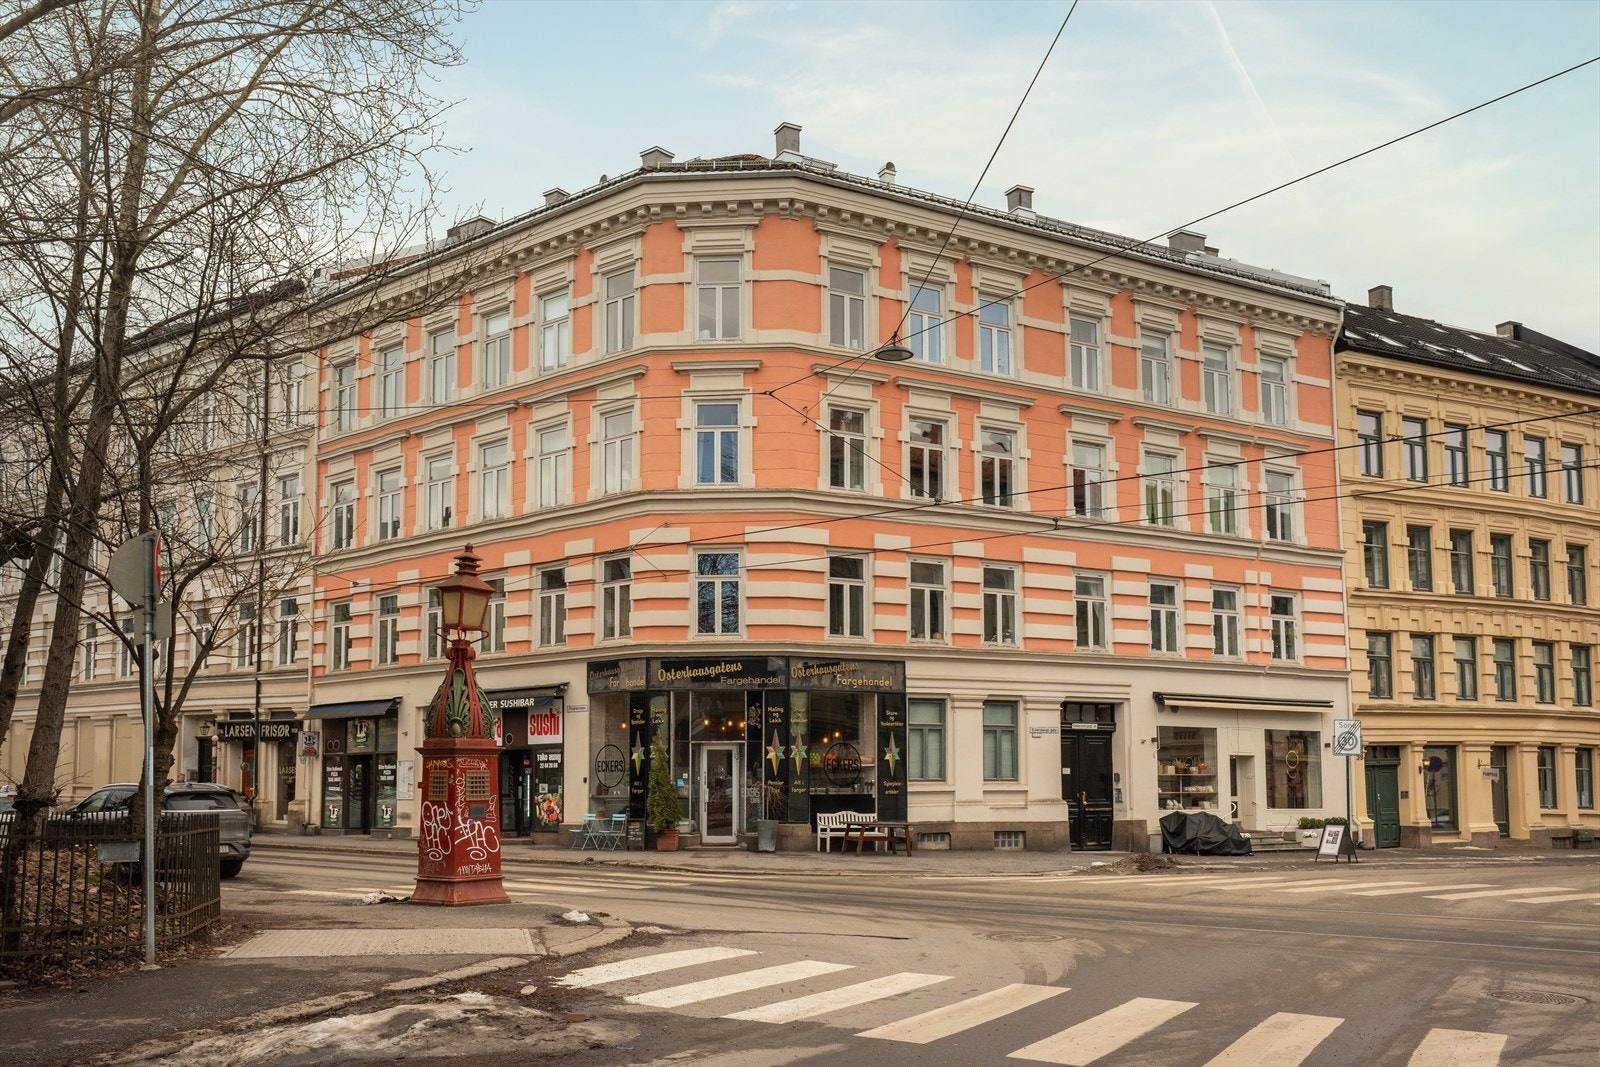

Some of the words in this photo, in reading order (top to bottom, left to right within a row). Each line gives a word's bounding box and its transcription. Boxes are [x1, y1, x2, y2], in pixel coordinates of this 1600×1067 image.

[658, 662, 743, 682] Osterhausgatens
[791, 662, 860, 679] Osterhausgatens
[720, 676, 782, 686] Fargehandel
[836, 674, 893, 688] Fargehandel
[500, 698, 534, 708] SUSHIBAR
[530, 708, 560, 736] sushi
[224, 725, 256, 737] LARSEN
[261, 724, 290, 737] FRISØR
[597, 760, 623, 772] ECKERS
[826, 759, 859, 772] ECKERS
